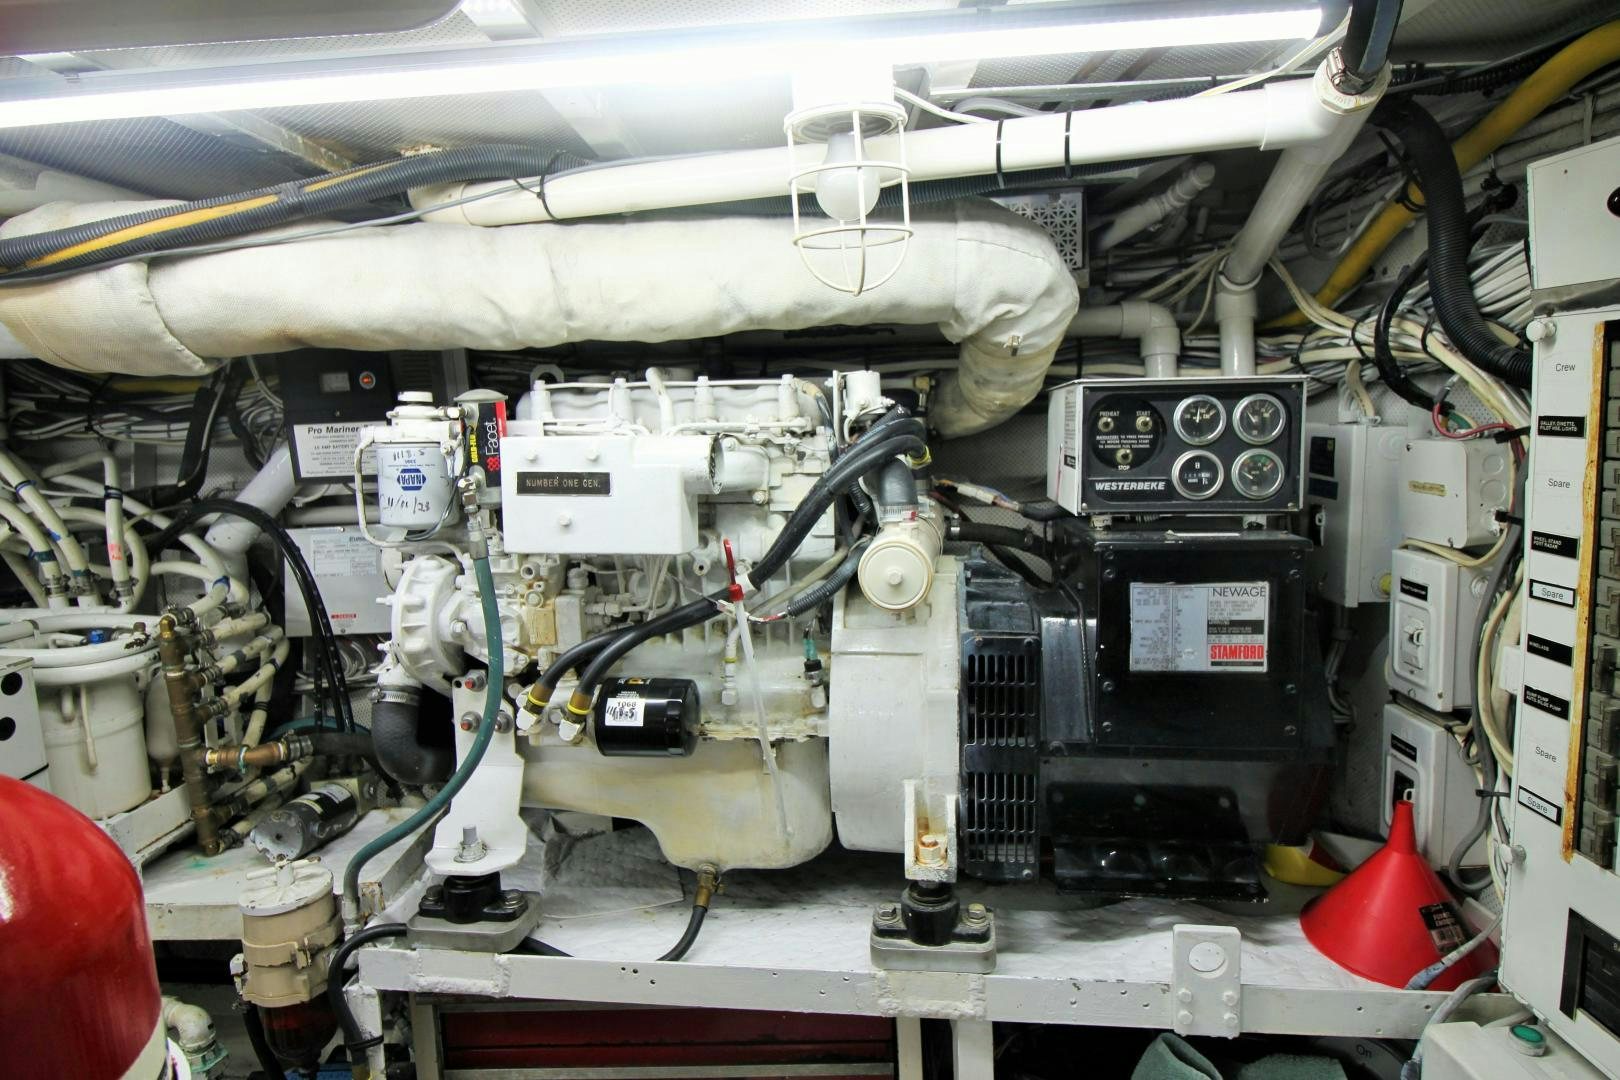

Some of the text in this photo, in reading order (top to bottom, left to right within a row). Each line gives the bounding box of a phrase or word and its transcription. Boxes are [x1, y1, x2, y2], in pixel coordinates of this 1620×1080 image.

[1555, 363, 1576, 372] Crew
[325, 425, 360, 434] Mariner
[400, 474, 422, 485] NAPA
[526, 479, 559, 488] NUMBER
[562, 479, 579, 488] ONE
[1547, 478, 1571, 489] Spare
[1095, 481, 1166, 491] WESTERBEKE
[1212, 586, 1266, 598] NEWAGE
[1541, 587, 1564, 600] Spare
[1210, 644, 1265, 660] STAMFORD
[1535, 746, 1557, 763] Spare
[1527, 796, 1548, 814] Spare
[1355, 1044, 1372, 1059] On
